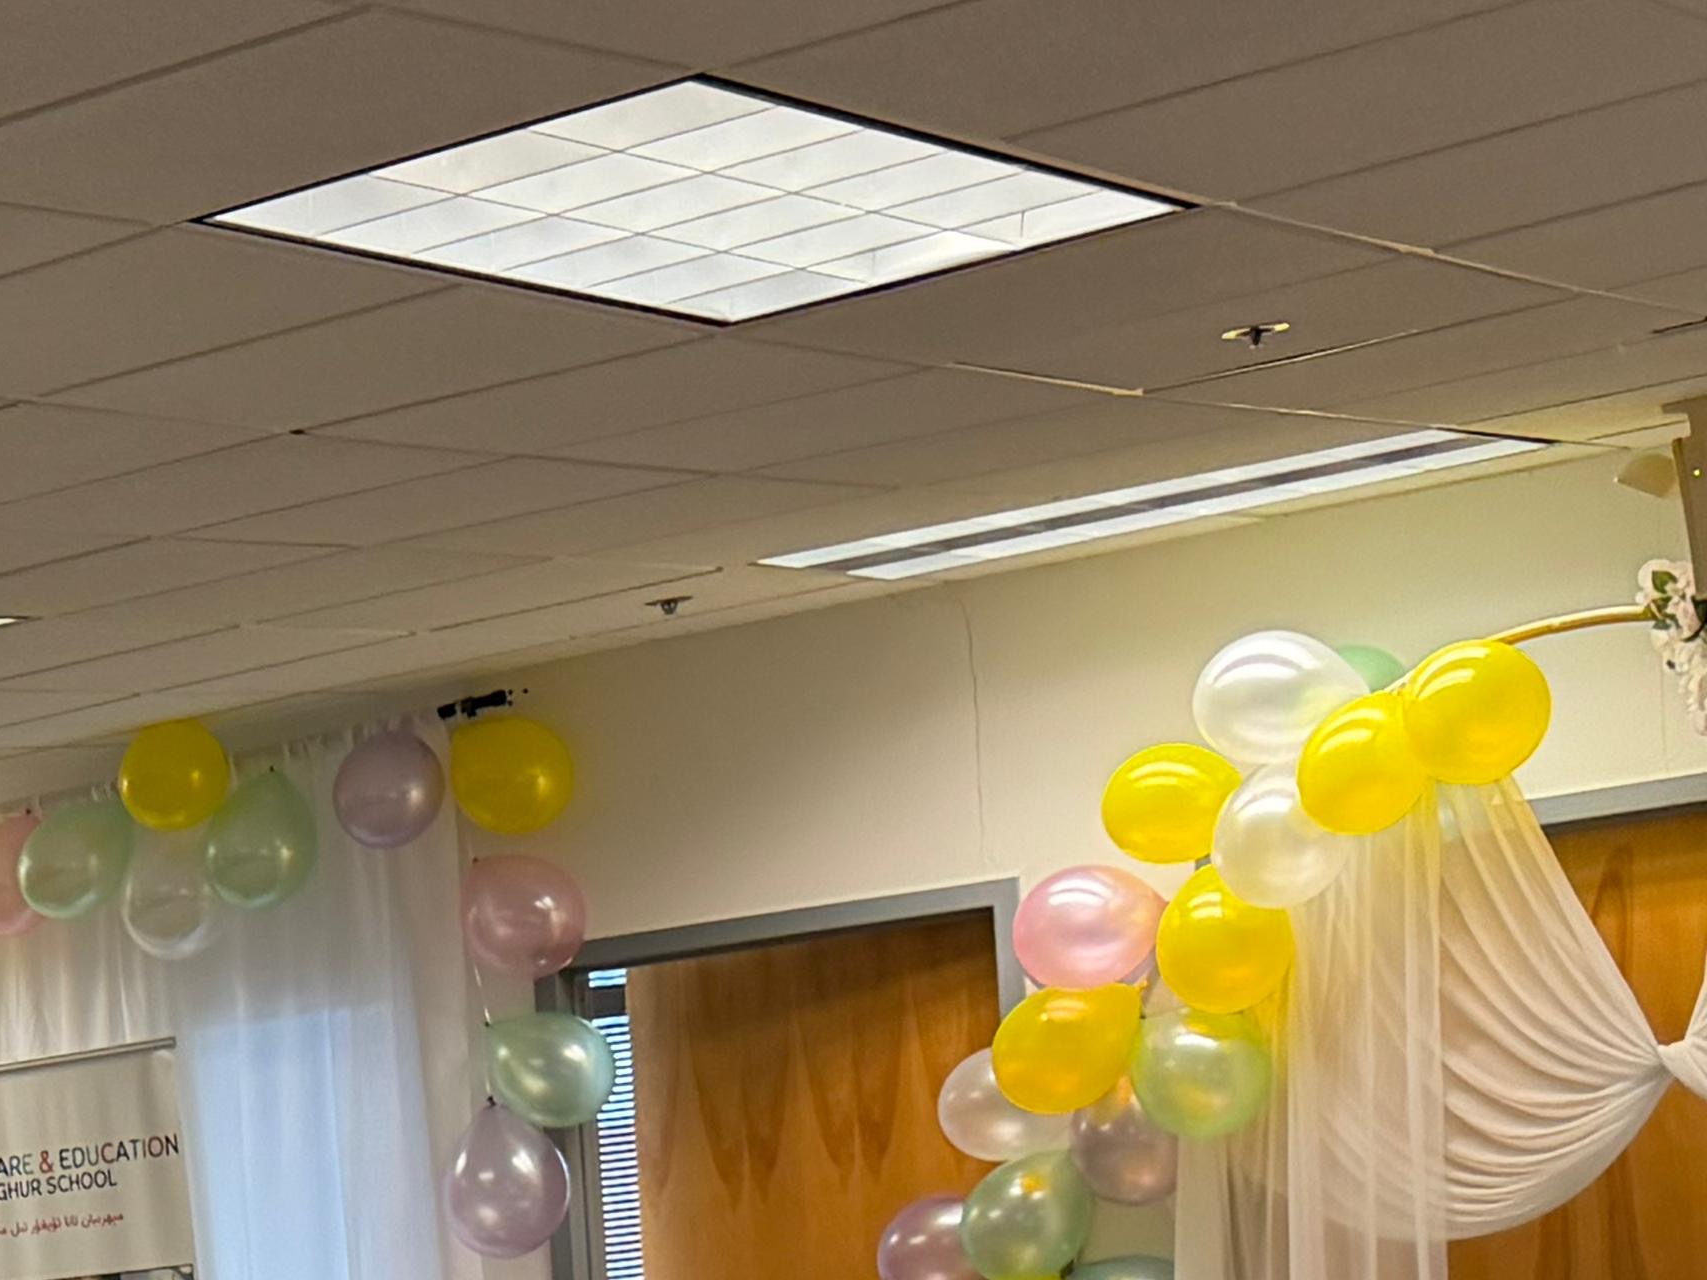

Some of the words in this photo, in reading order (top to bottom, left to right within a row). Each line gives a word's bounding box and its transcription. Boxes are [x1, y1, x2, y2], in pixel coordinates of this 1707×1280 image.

[39, 1150, 54, 1174] &
[59, 1133, 180, 1171] EDUCATION
[46, 1169, 117, 1195] SCHOOL
